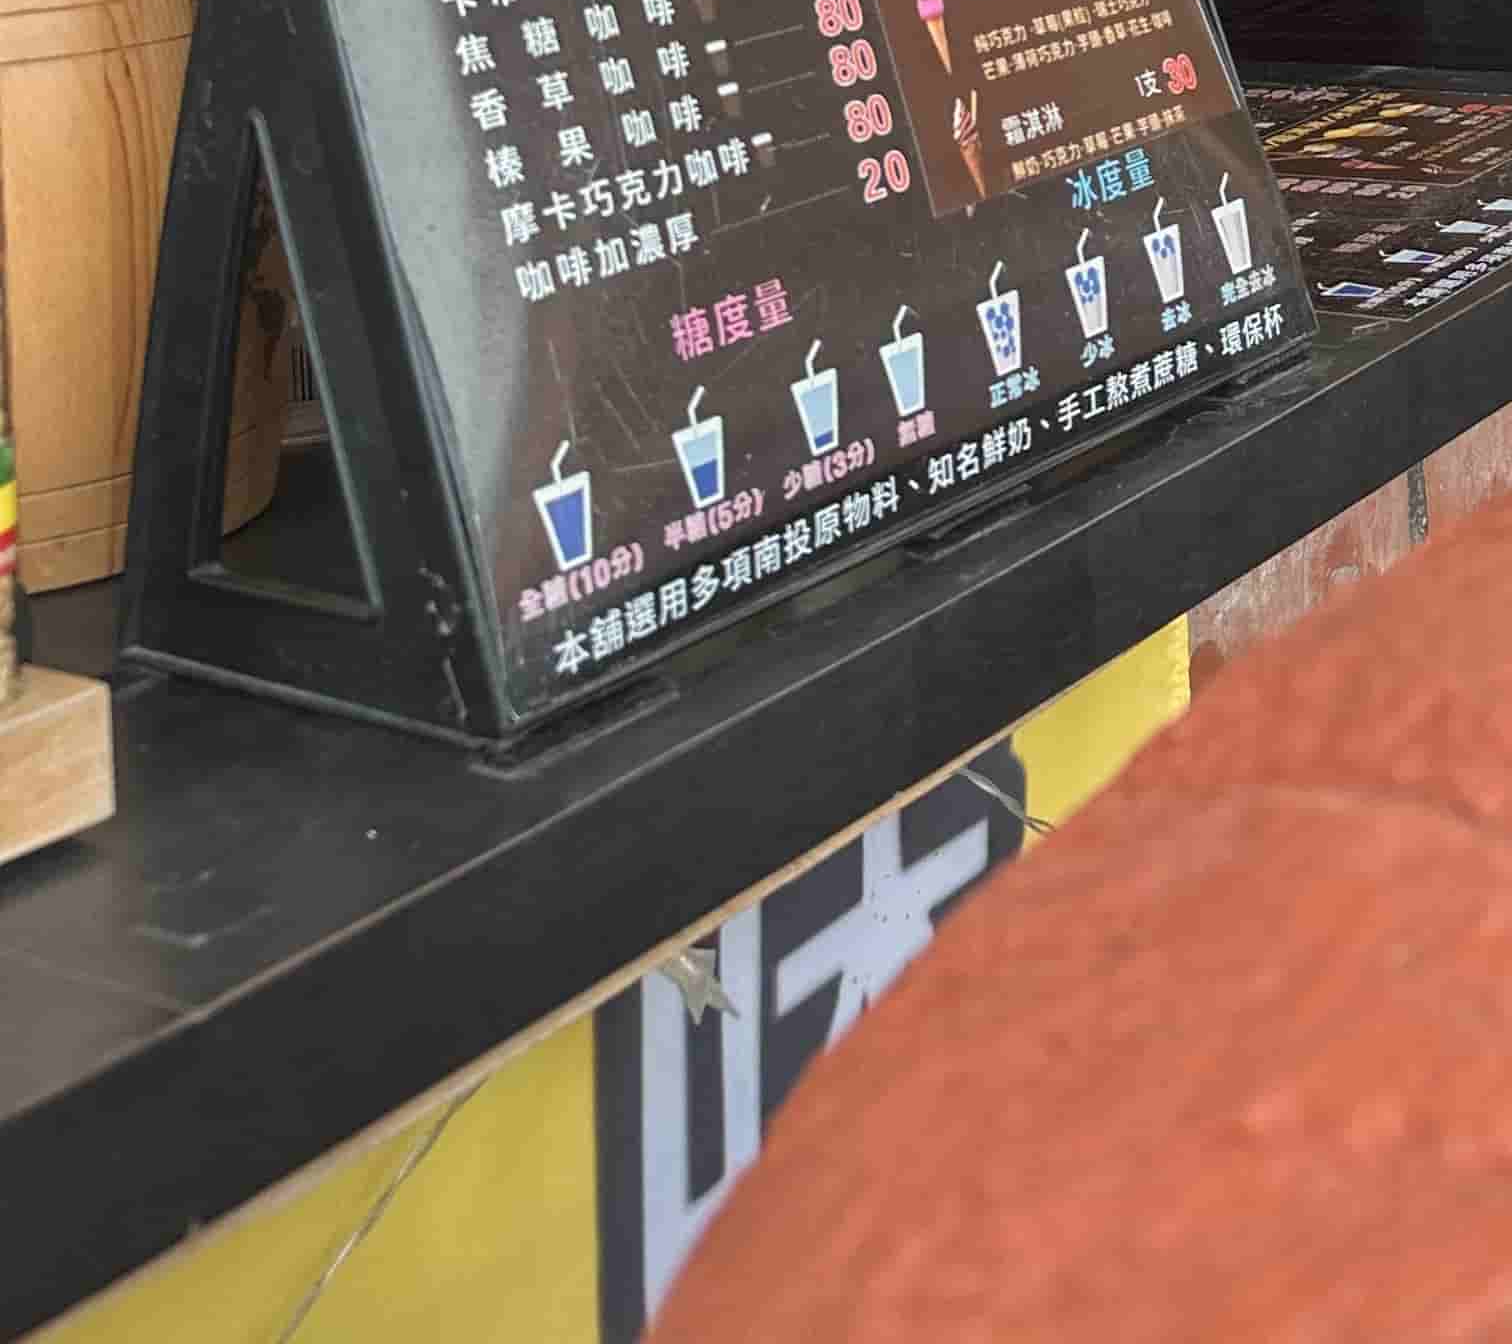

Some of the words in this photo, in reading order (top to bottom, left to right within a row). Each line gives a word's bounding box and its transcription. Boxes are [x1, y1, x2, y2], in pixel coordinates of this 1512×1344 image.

[469, 39, 692, 133] 香草咖啡
[827, 37, 879, 88] 80
[1161, 53, 1199, 96] 30
[484, 94, 705, 190] 榛果咖啡
[843, 92, 895, 143] 80
[1000, 100, 1065, 147] 霜淇淋
[500, 136, 753, 248] 摩卡巧克力咖啡
[856, 148, 912, 205] 20
[1064, 145, 1156, 212] 冰度量
[514, 211, 700, 305] 咖啡加濃厚
[668, 276, 796, 364] 糖度量
[1159, 300, 1193, 335] 去冰
[1079, 332, 1117, 369] 少冰
[987, 368, 1042, 408] 正常冰
[517, 540, 645, 623] 全糖(10分)
